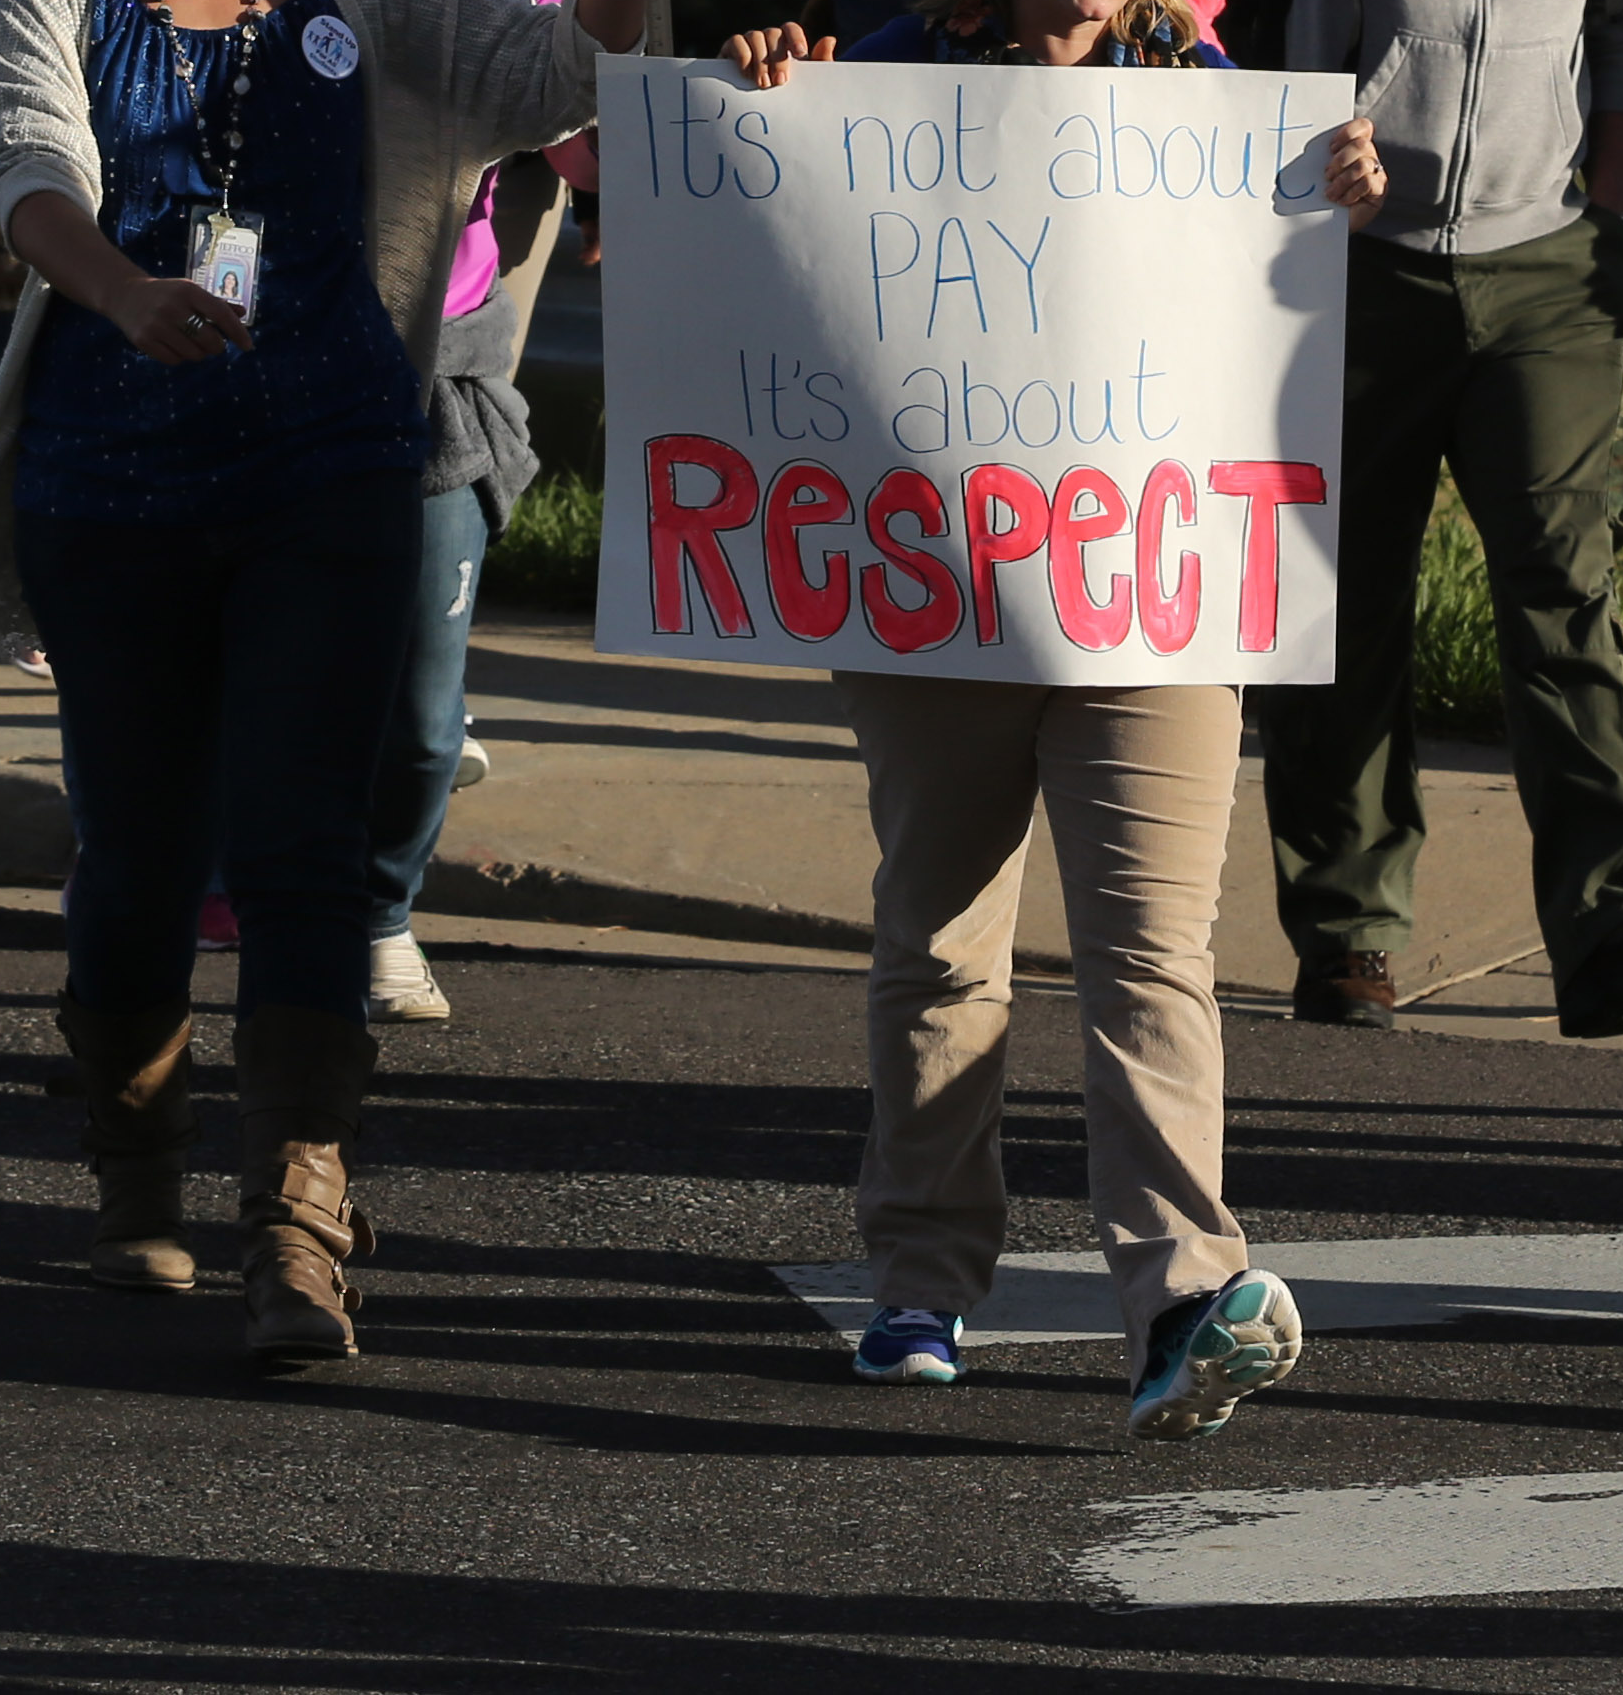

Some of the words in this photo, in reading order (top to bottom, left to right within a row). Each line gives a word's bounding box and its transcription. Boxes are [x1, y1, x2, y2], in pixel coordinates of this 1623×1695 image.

[641, 74, 781, 199] It's
[843, 84, 997, 195] not
[1048, 83, 1319, 201] about
[869, 211, 1052, 342] PAY
[739, 347, 851, 443] It's
[891, 338, 1180, 455] about
